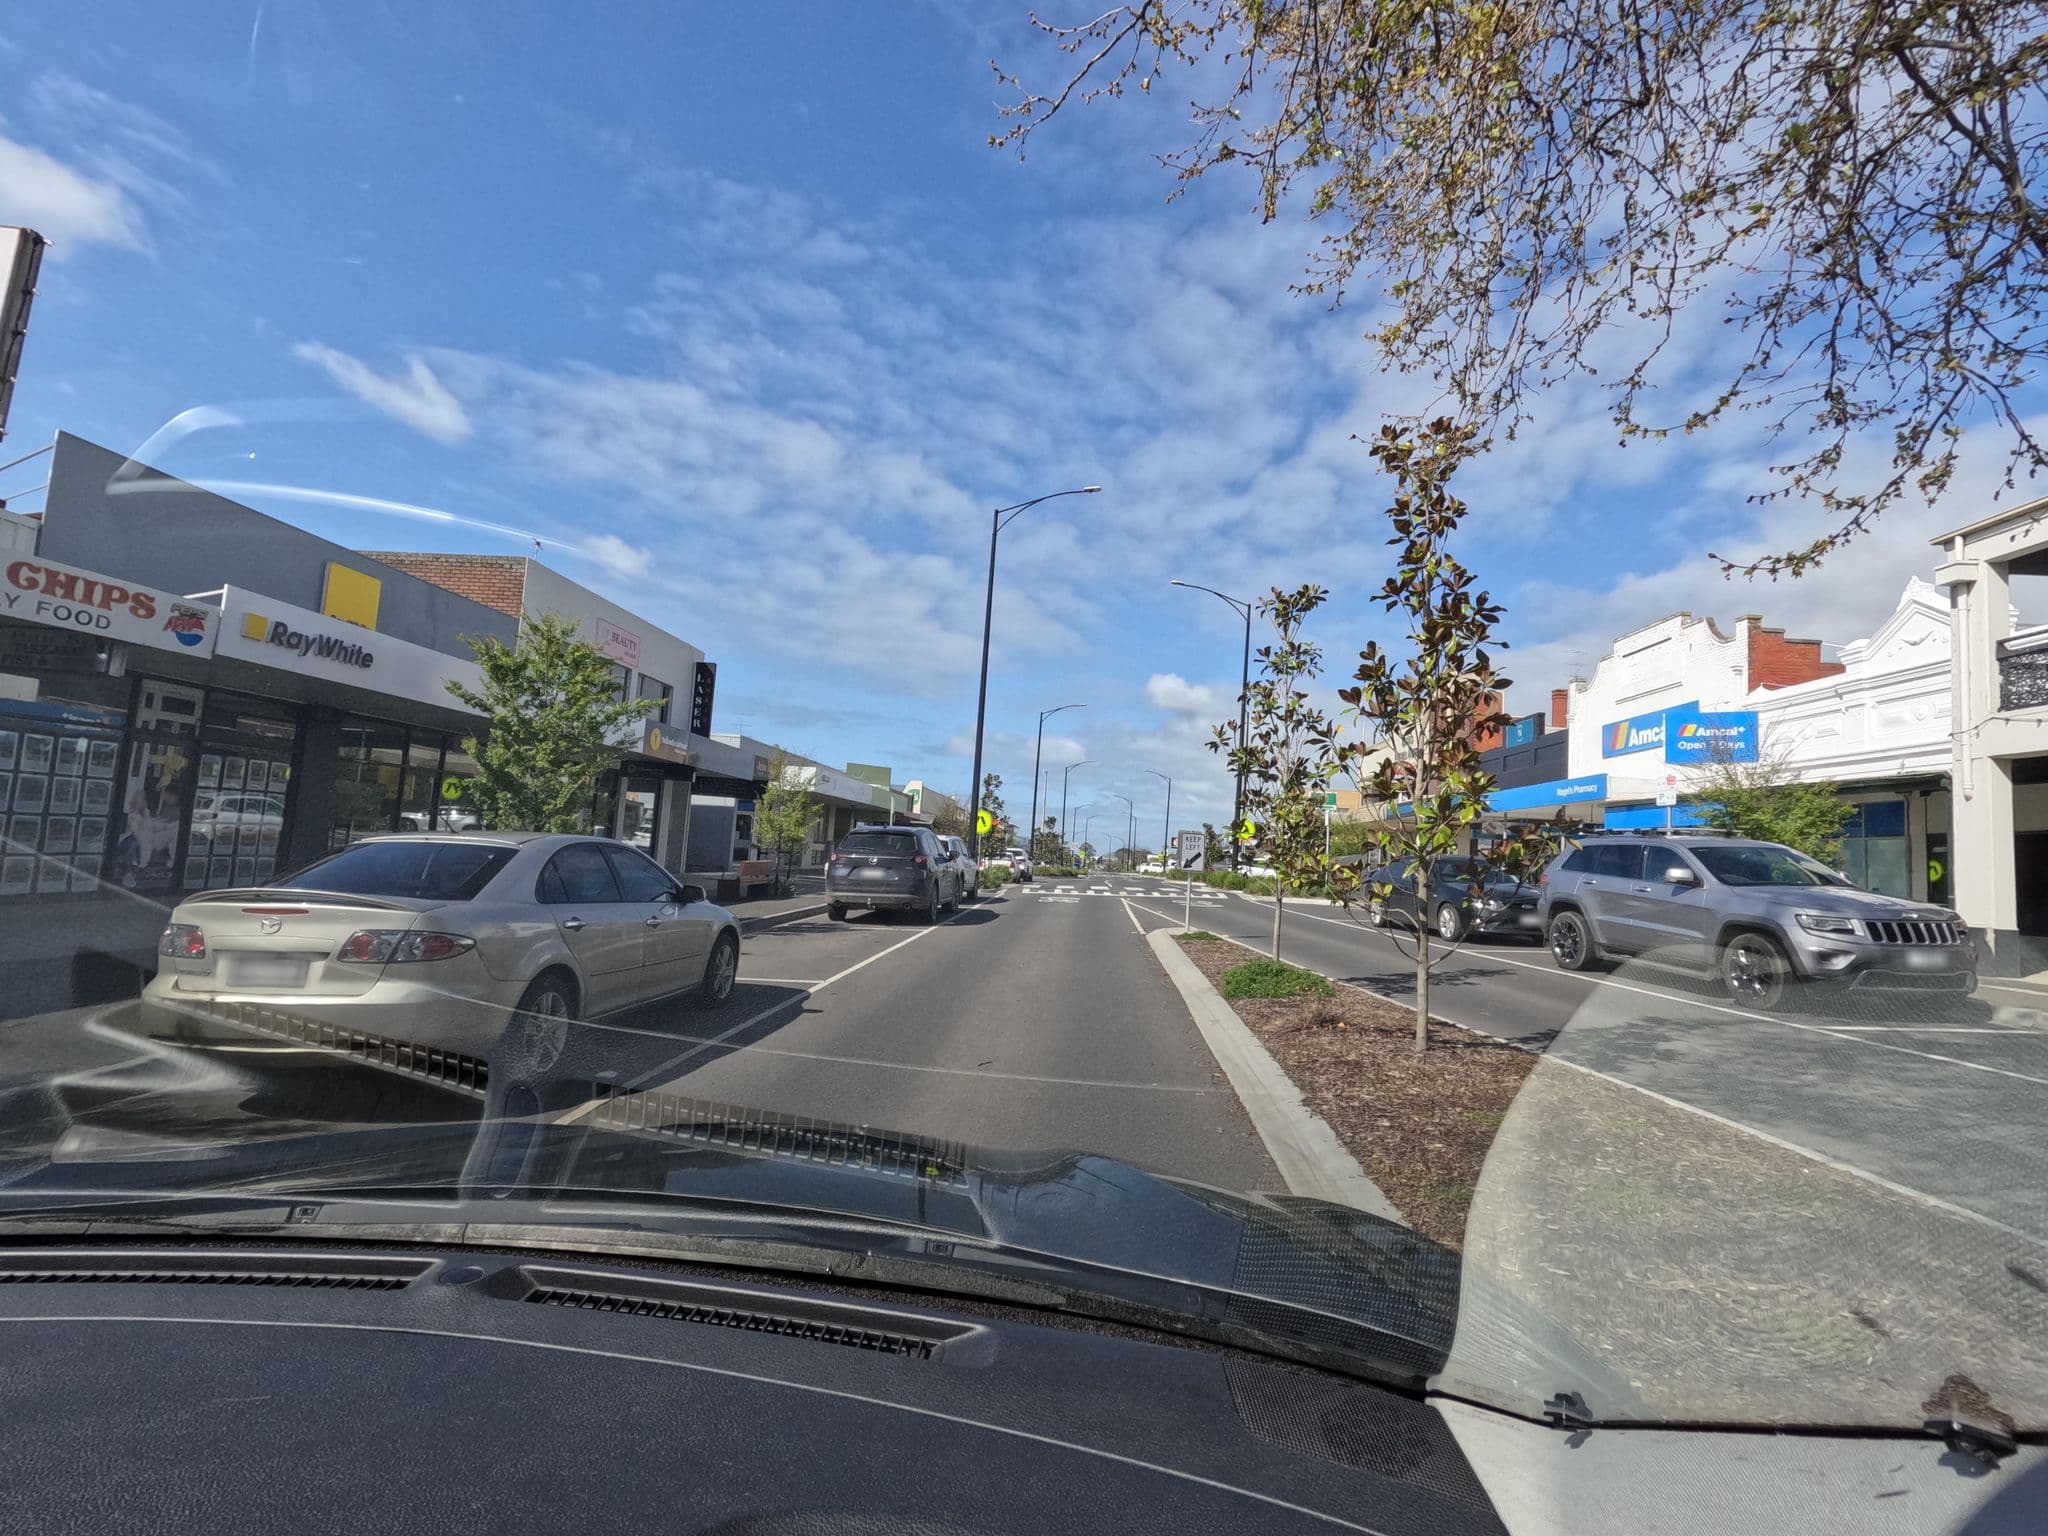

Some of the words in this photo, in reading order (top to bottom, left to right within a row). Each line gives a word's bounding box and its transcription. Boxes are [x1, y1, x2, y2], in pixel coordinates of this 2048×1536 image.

[6, 561, 156, 619] CHIPS
[36, 600, 111, 629] FOOD
[611, 632, 637, 652] BEAUTY
[693, 673, 704, 728] LASER
[1678, 741, 1706, 750] Open
[1719, 740, 1746, 750] Days
